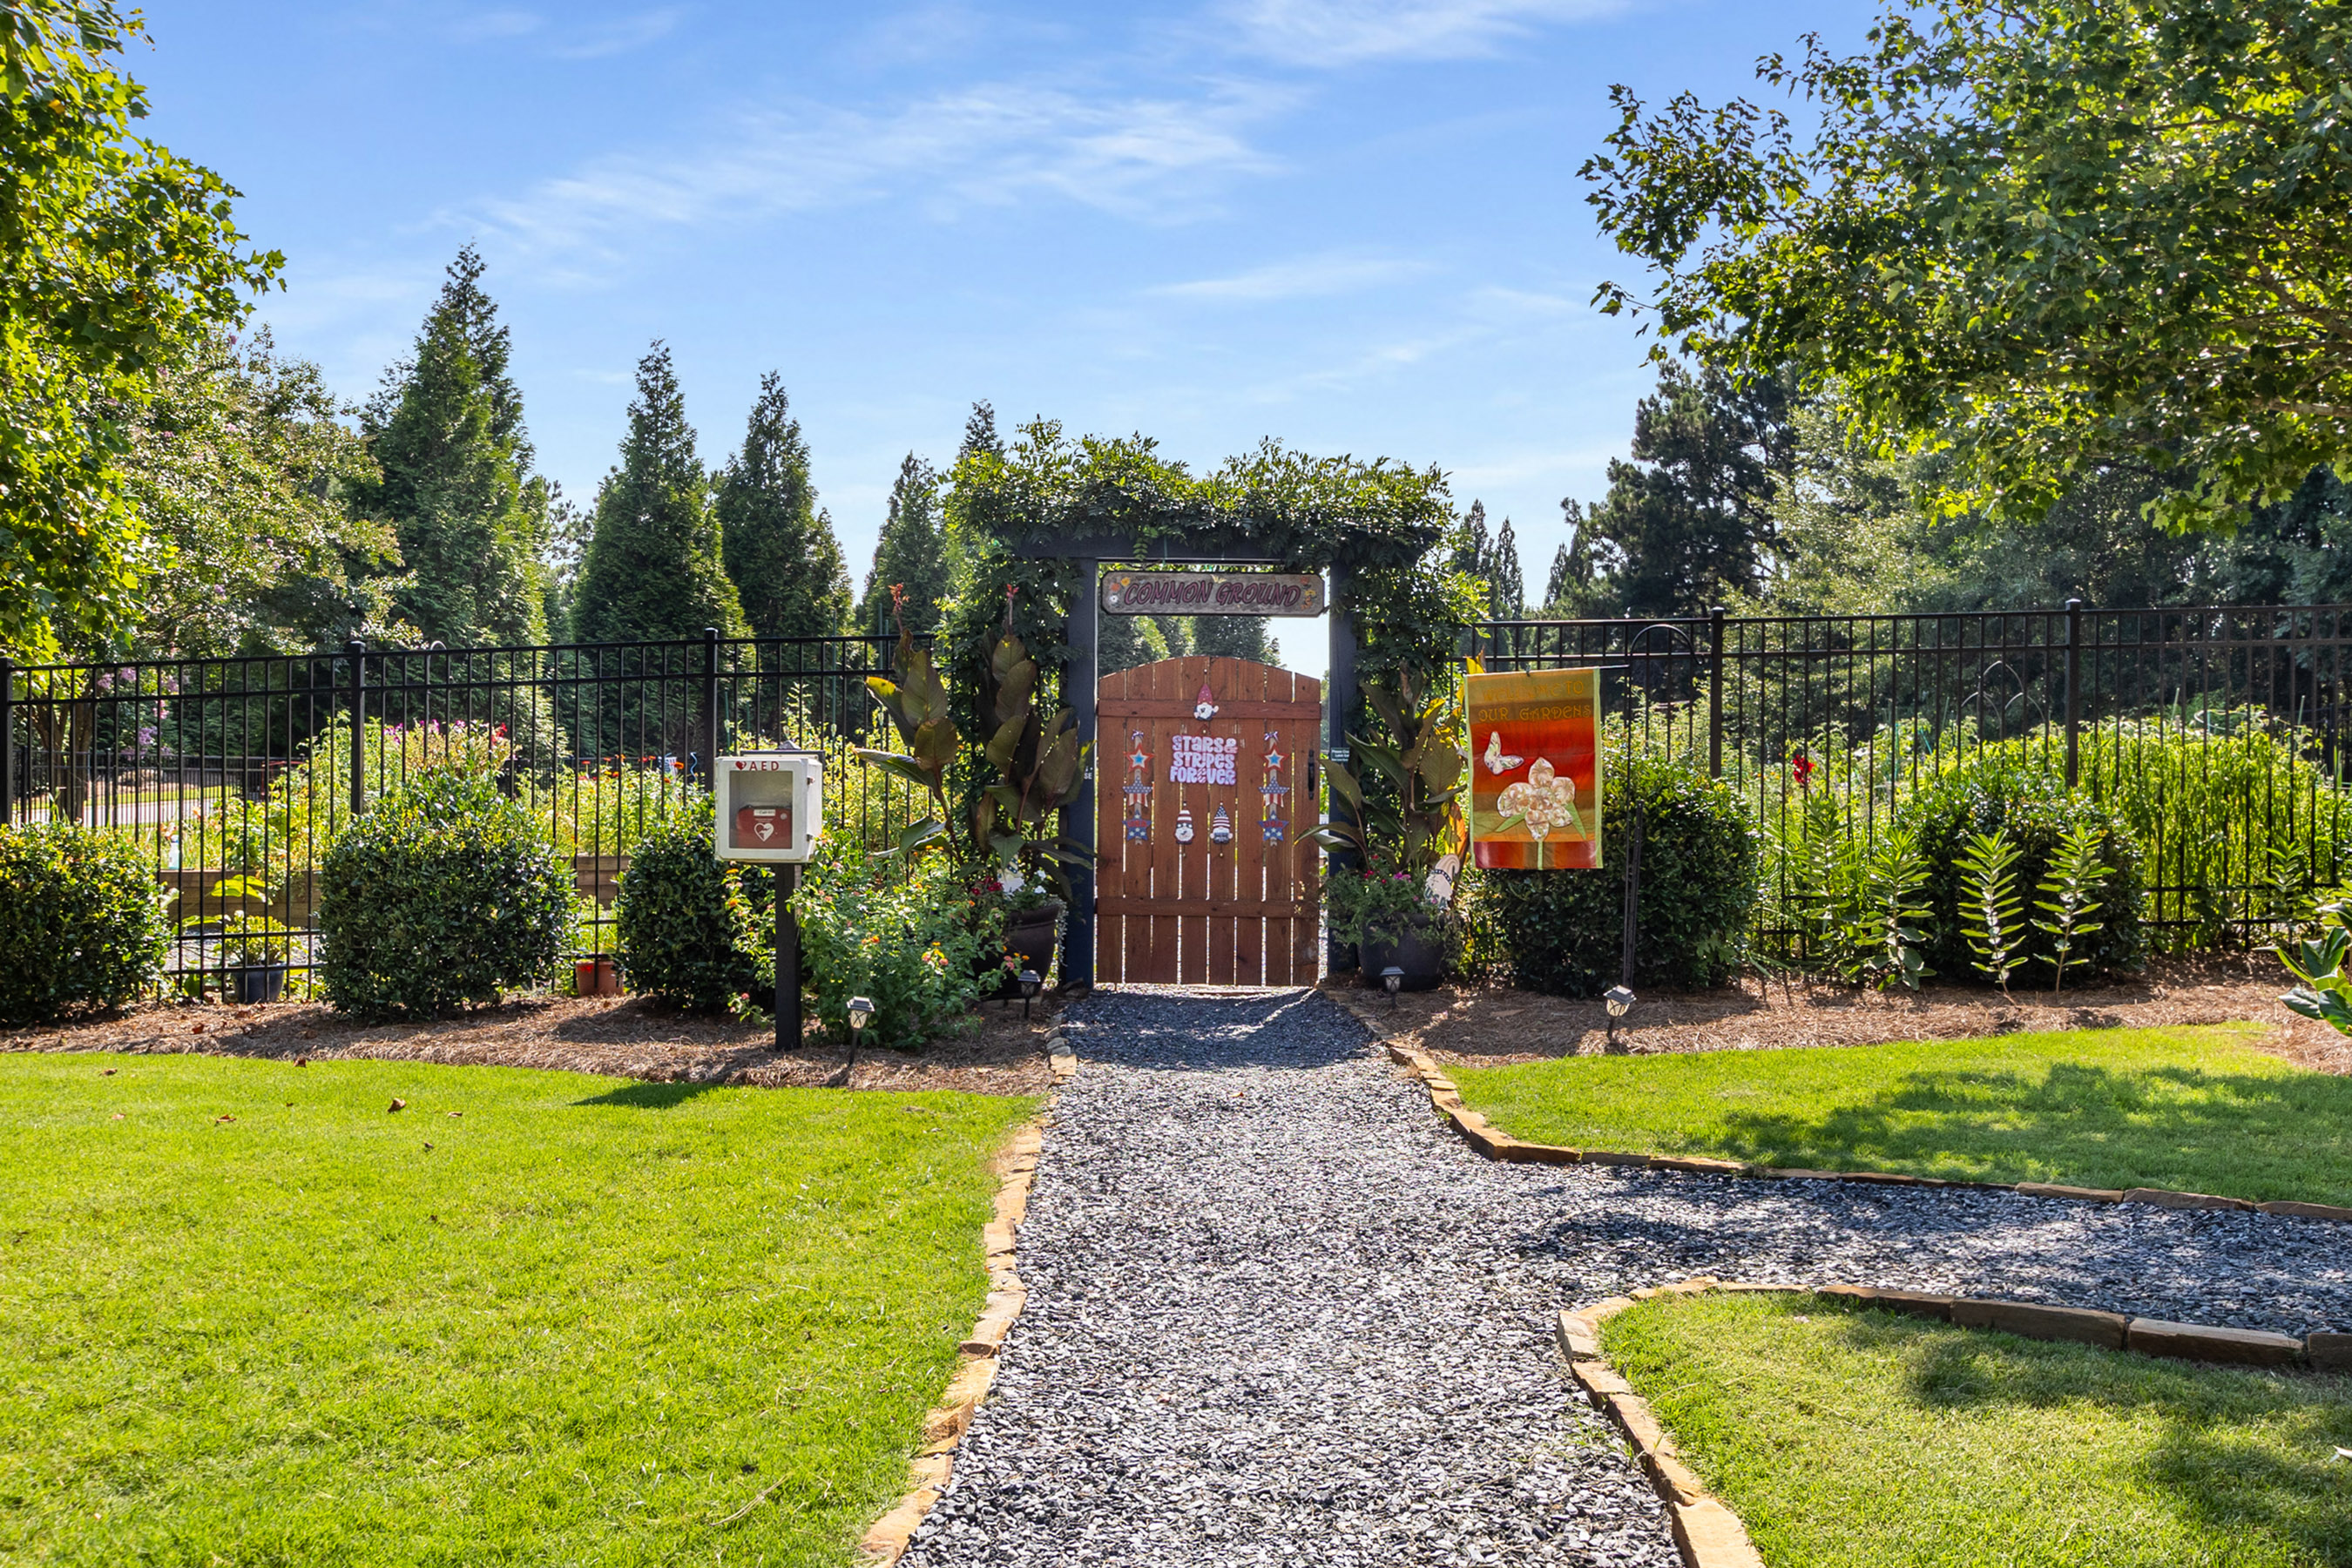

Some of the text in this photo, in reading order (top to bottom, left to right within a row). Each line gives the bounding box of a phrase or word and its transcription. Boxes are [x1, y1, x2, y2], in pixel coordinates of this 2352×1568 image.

[1125, 580, 1301, 607] COMMON GROUND
[1565, 680, 1584, 695] TO
[1478, 705, 1592, 722] OUR GARDENS
[749, 760, 780, 771] AED
